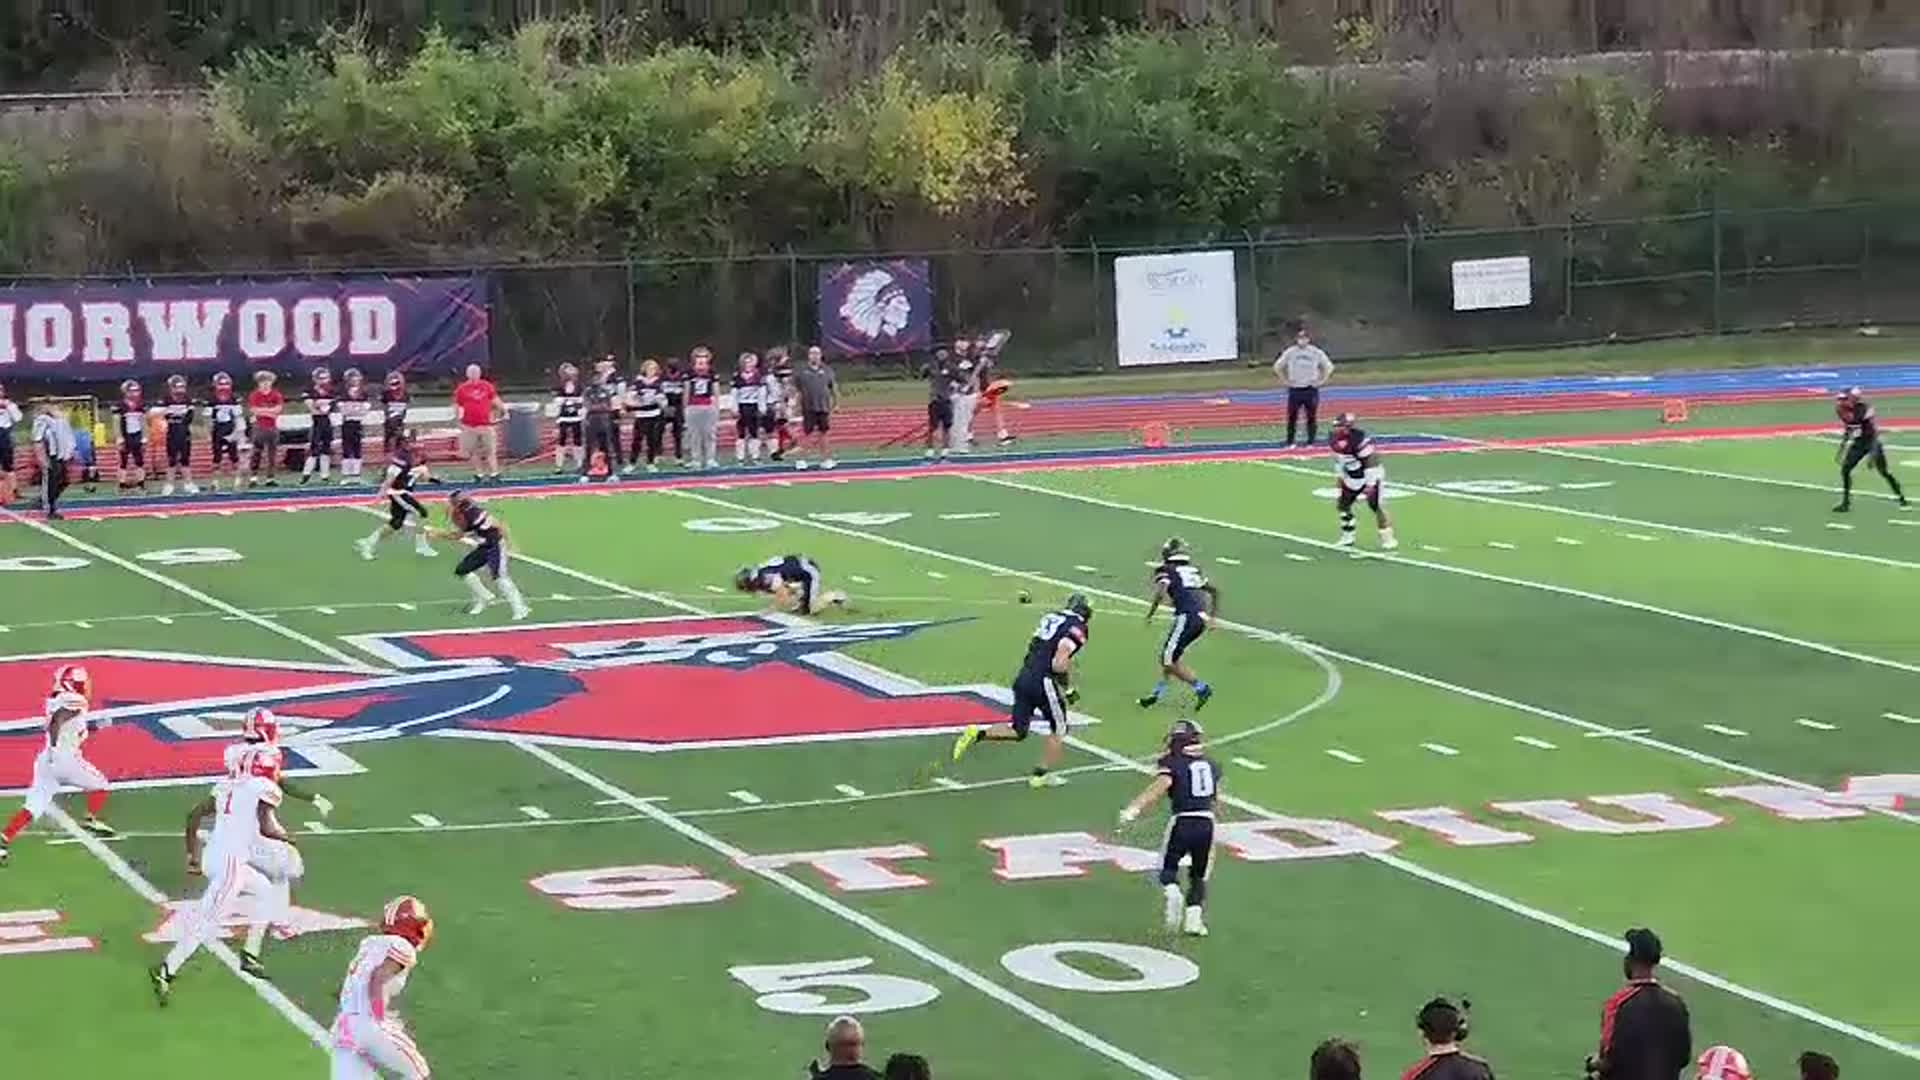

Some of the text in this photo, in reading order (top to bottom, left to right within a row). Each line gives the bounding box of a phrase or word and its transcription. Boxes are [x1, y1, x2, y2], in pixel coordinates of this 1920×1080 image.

[1189, 759, 1215, 798] 0
[529, 773, 1920, 911] STADIUM
[727, 940, 1201, 1015] 50
